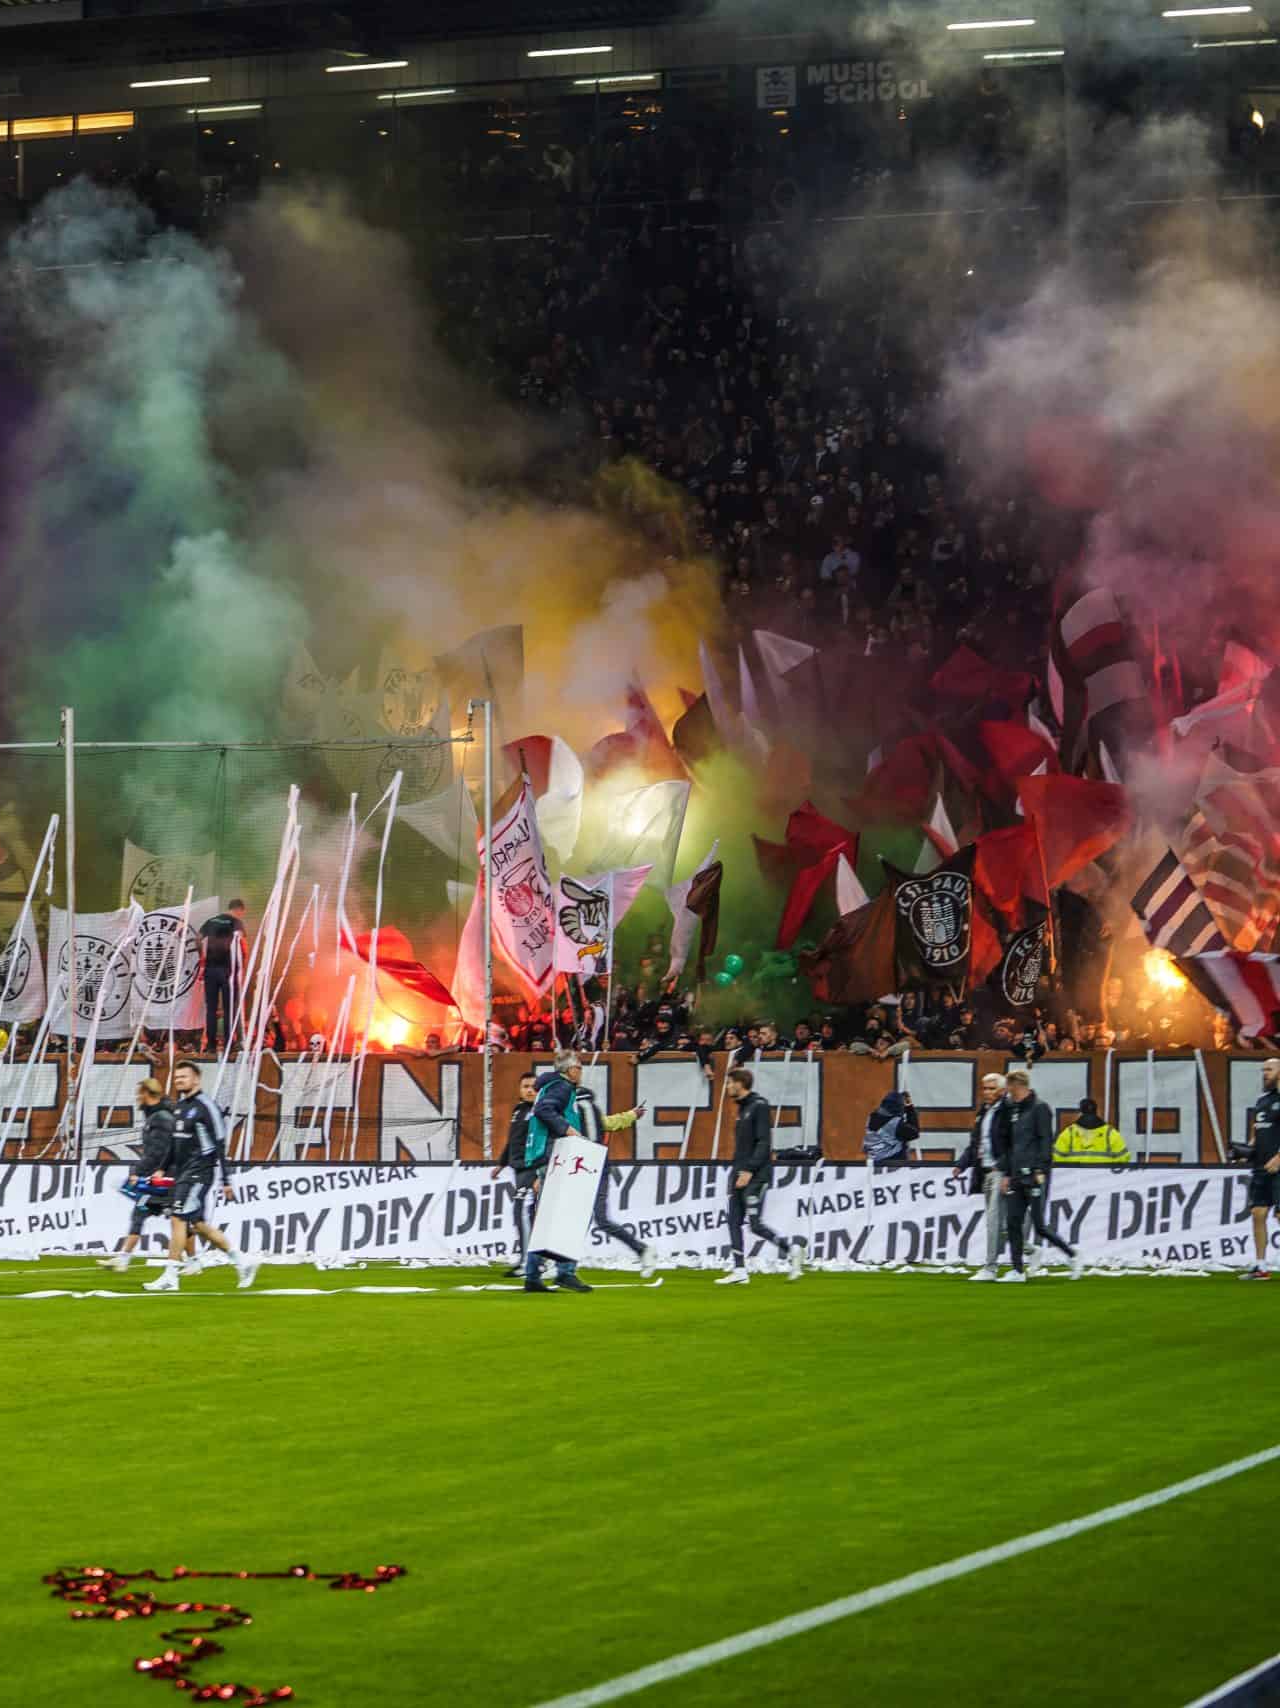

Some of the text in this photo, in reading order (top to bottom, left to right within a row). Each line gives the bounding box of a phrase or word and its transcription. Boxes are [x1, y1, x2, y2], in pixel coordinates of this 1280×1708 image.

[807, 61, 897, 85] MUSIC
[823, 79, 933, 104] SCHOOL
[926, 943, 960, 962] 1910
[267, 1165, 418, 1200] SPORTSWEAR
[797, 1191, 865, 1218] MADE
[873, 1184, 901, 1206] BY
[910, 1180, 936, 1202] FC
[28, 1208, 88, 1233] PAULI
[1219, 1234, 1249, 1257] BY
